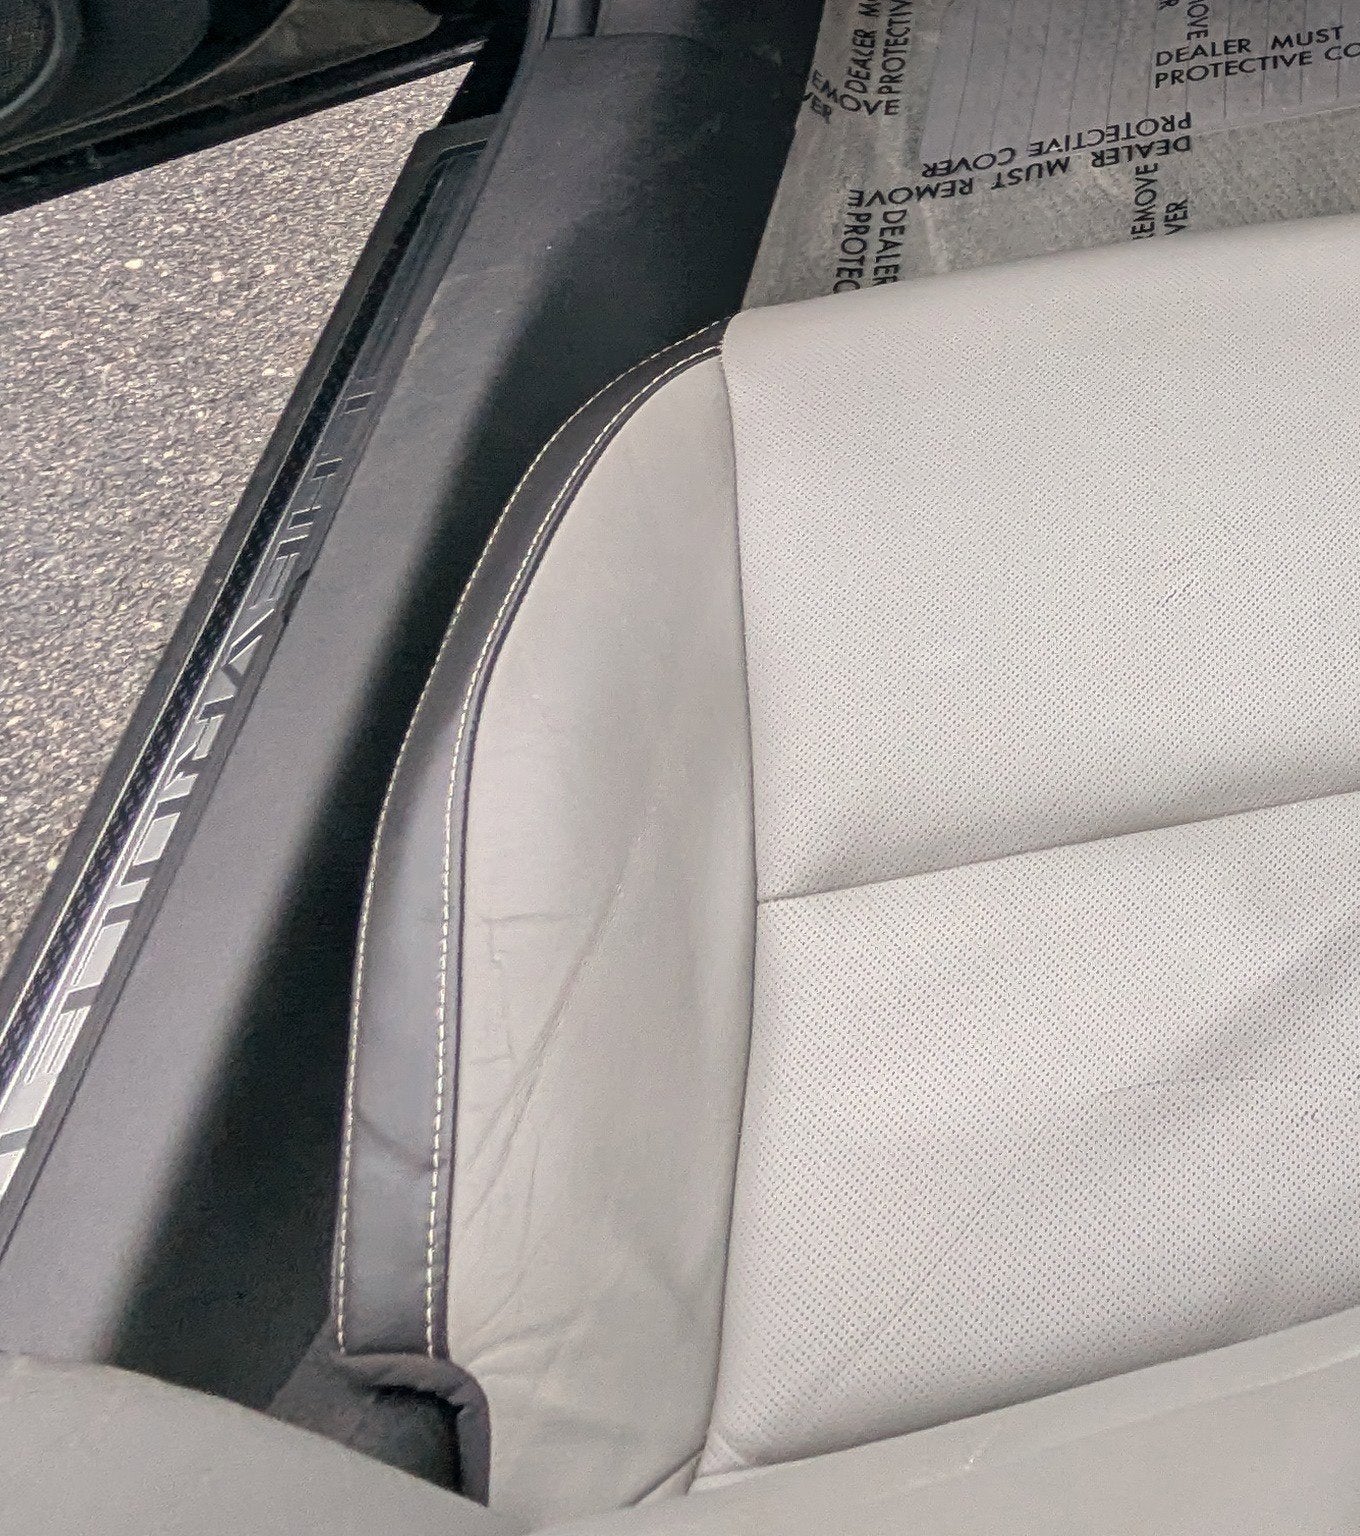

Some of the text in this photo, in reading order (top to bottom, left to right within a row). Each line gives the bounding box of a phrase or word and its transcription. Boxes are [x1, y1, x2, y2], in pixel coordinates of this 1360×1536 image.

[846, 28, 877, 95] DEALER
[1154, 51, 1315, 88] PROTECTIVE
[1156, 35, 1252, 67] DEALER
[1270, 25, 1344, 50] MUST
[847, 135, 1192, 207] DEALER MUST REMOVE
[921, 112, 1193, 178] PROTECTIVE COVER
[1131, 163, 1159, 240] EMOVE
[873, 209, 907, 287] DEALER
